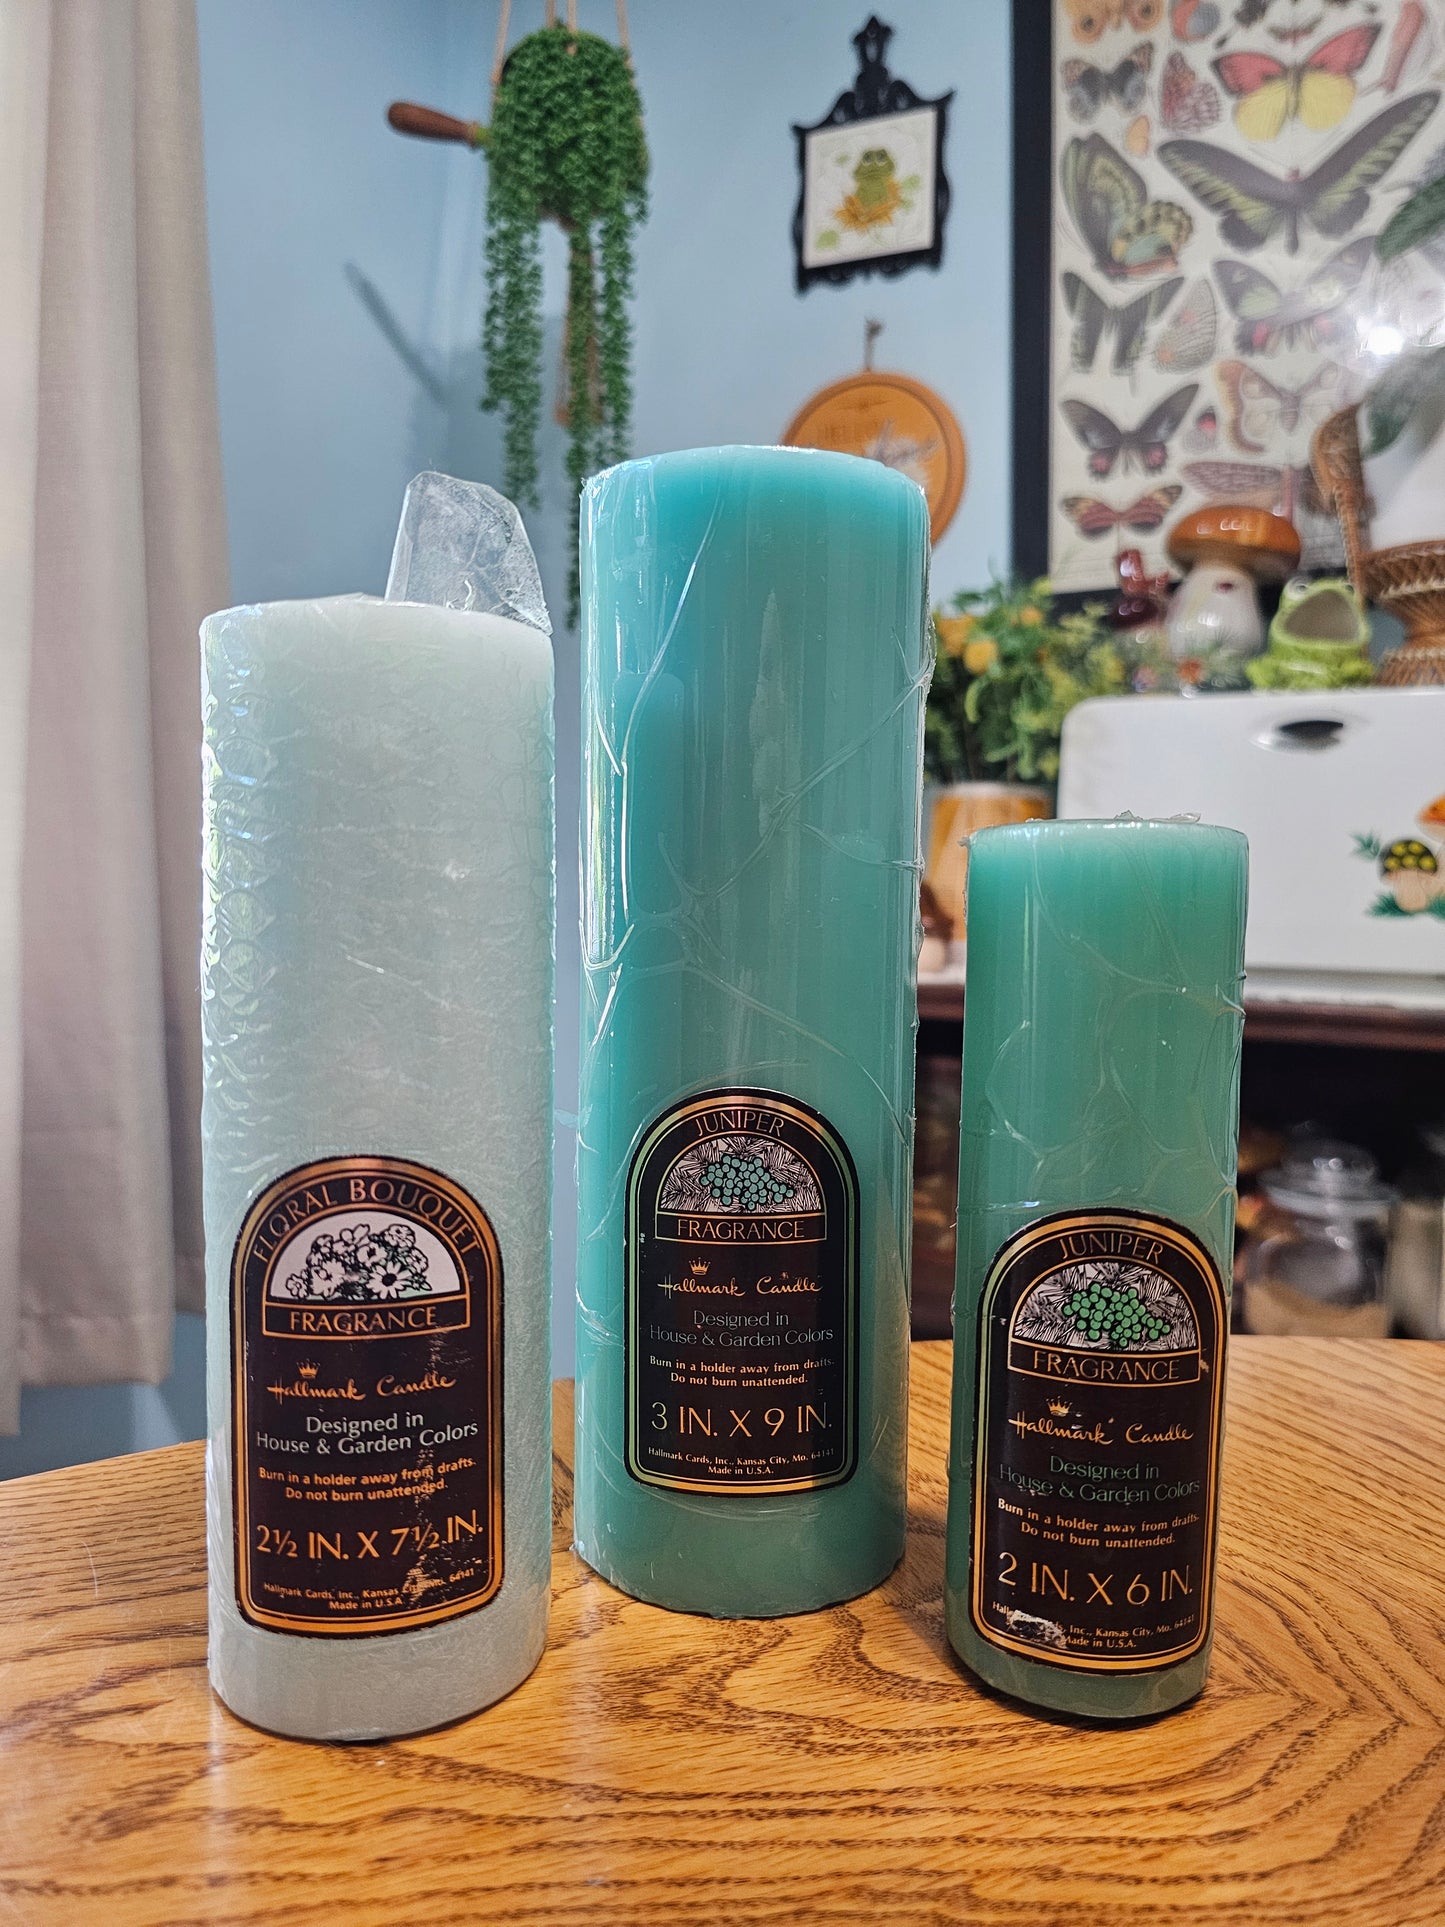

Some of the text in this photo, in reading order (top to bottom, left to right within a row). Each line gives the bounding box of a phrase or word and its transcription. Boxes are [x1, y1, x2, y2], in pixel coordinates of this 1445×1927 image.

[696, 1110, 784, 1137] JUNIPER
[253, 1178, 481, 1263] FLORAL BOUQUET
[677, 1219, 805, 1240] FRAGRANCE
[1058, 1233, 1164, 1265] JUNIPER
[657, 1273, 823, 1299] Hallmark Candle
[290, 1305, 438, 1333] FRAGRANCE
[693, 1310, 789, 1330] Designed in
[650, 1324, 834, 1347] House & Garden Colors
[649, 1355, 835, 1375] Burn in a holder away from drafts.
[1034, 1350, 1180, 1381] FRAGRANCE
[266, 1372, 457, 1405] Hallmark Candle
[671, 1372, 808, 1388] Do not burn unattended.
[306, 1412, 424, 1438] Designed in
[651, 1402, 833, 1437] 3 IN. X 9 IN.
[1007, 1410, 1194, 1445] Hallmark Candle
[256, 1421, 479, 1455] House & Garden Colors
[648, 1447, 683, 1461] Hallmark
[685, 1453, 712, 1466] Cards,
[737, 1457, 767, 1466] Kansas
[769, 1455, 790, 1465] City,
[792, 1454, 809, 1462] Mo.
[1050, 1455, 1159, 1482] Designed in
[258, 1456, 477, 1486] Burn in a holder away from drafts.
[708, 1466, 774, 1475] Made in U.S.A.
[1000, 1463, 1200, 1503] House & Garden Colors
[285, 1479, 449, 1502] Do not burn unattended.
[998, 1498, 1200, 1533] Burn in a holder away from drafts.
[308, 1531, 350, 1560] IN.
[357, 1531, 380, 1559] X
[447, 1509, 484, 1544] IN.
[1021, 1521, 1176, 1548] Do not burn unattended.
[263, 1582, 302, 1597] Hallmark
[362, 1588, 399, 1599] Kansas
[998, 1552, 1193, 1605] 2 IN. X 6 IN.
[329, 1600, 359, 1610] Made
[362, 1601, 372, 1609] in
[1093, 1638, 1102, 1647] in
[1106, 1639, 1137, 1648] U.S.A.
[1096, 1628, 1129, 1637] Kansas
[1132, 1627, 1154, 1637] City,
[1156, 1625, 1172, 1633] Mo.
